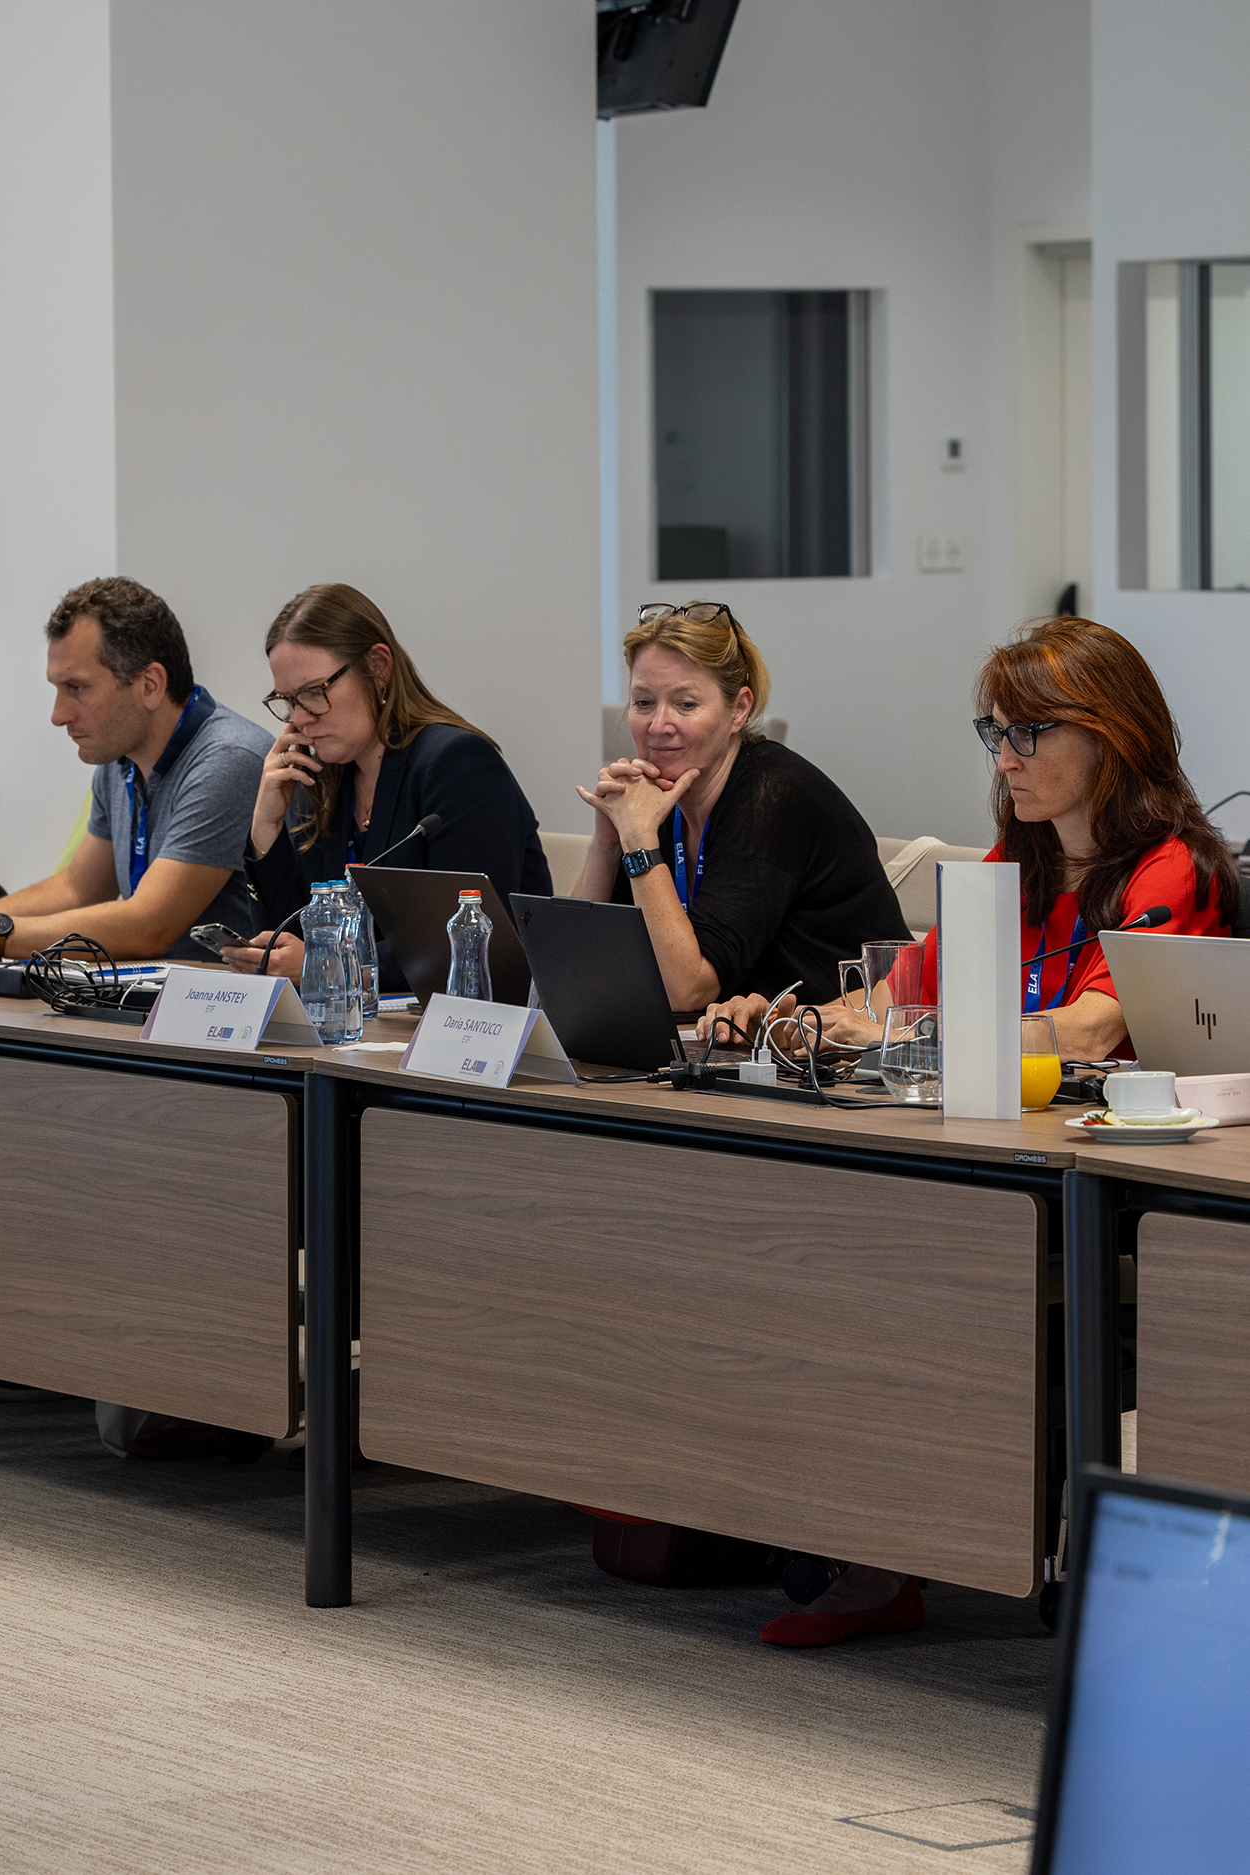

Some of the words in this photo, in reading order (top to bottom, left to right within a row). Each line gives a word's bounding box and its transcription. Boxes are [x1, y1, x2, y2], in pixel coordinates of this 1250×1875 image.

[135, 837, 145, 856] ELA
[676, 842, 684, 864] ELA
[1028, 973, 1038, 994] ELA
[185, 988, 213, 1001] Joanna
[213, 990, 248, 1004] ANSTEY
[205, 1005, 216, 1013] ETF
[207, 1026, 224, 1038] ELA
[444, 1015, 463, 1030] Daria
[463, 1018, 503, 1036] SANTUCCI
[461, 1035, 472, 1044] ETF
[461, 1058, 478, 1072] ELA
